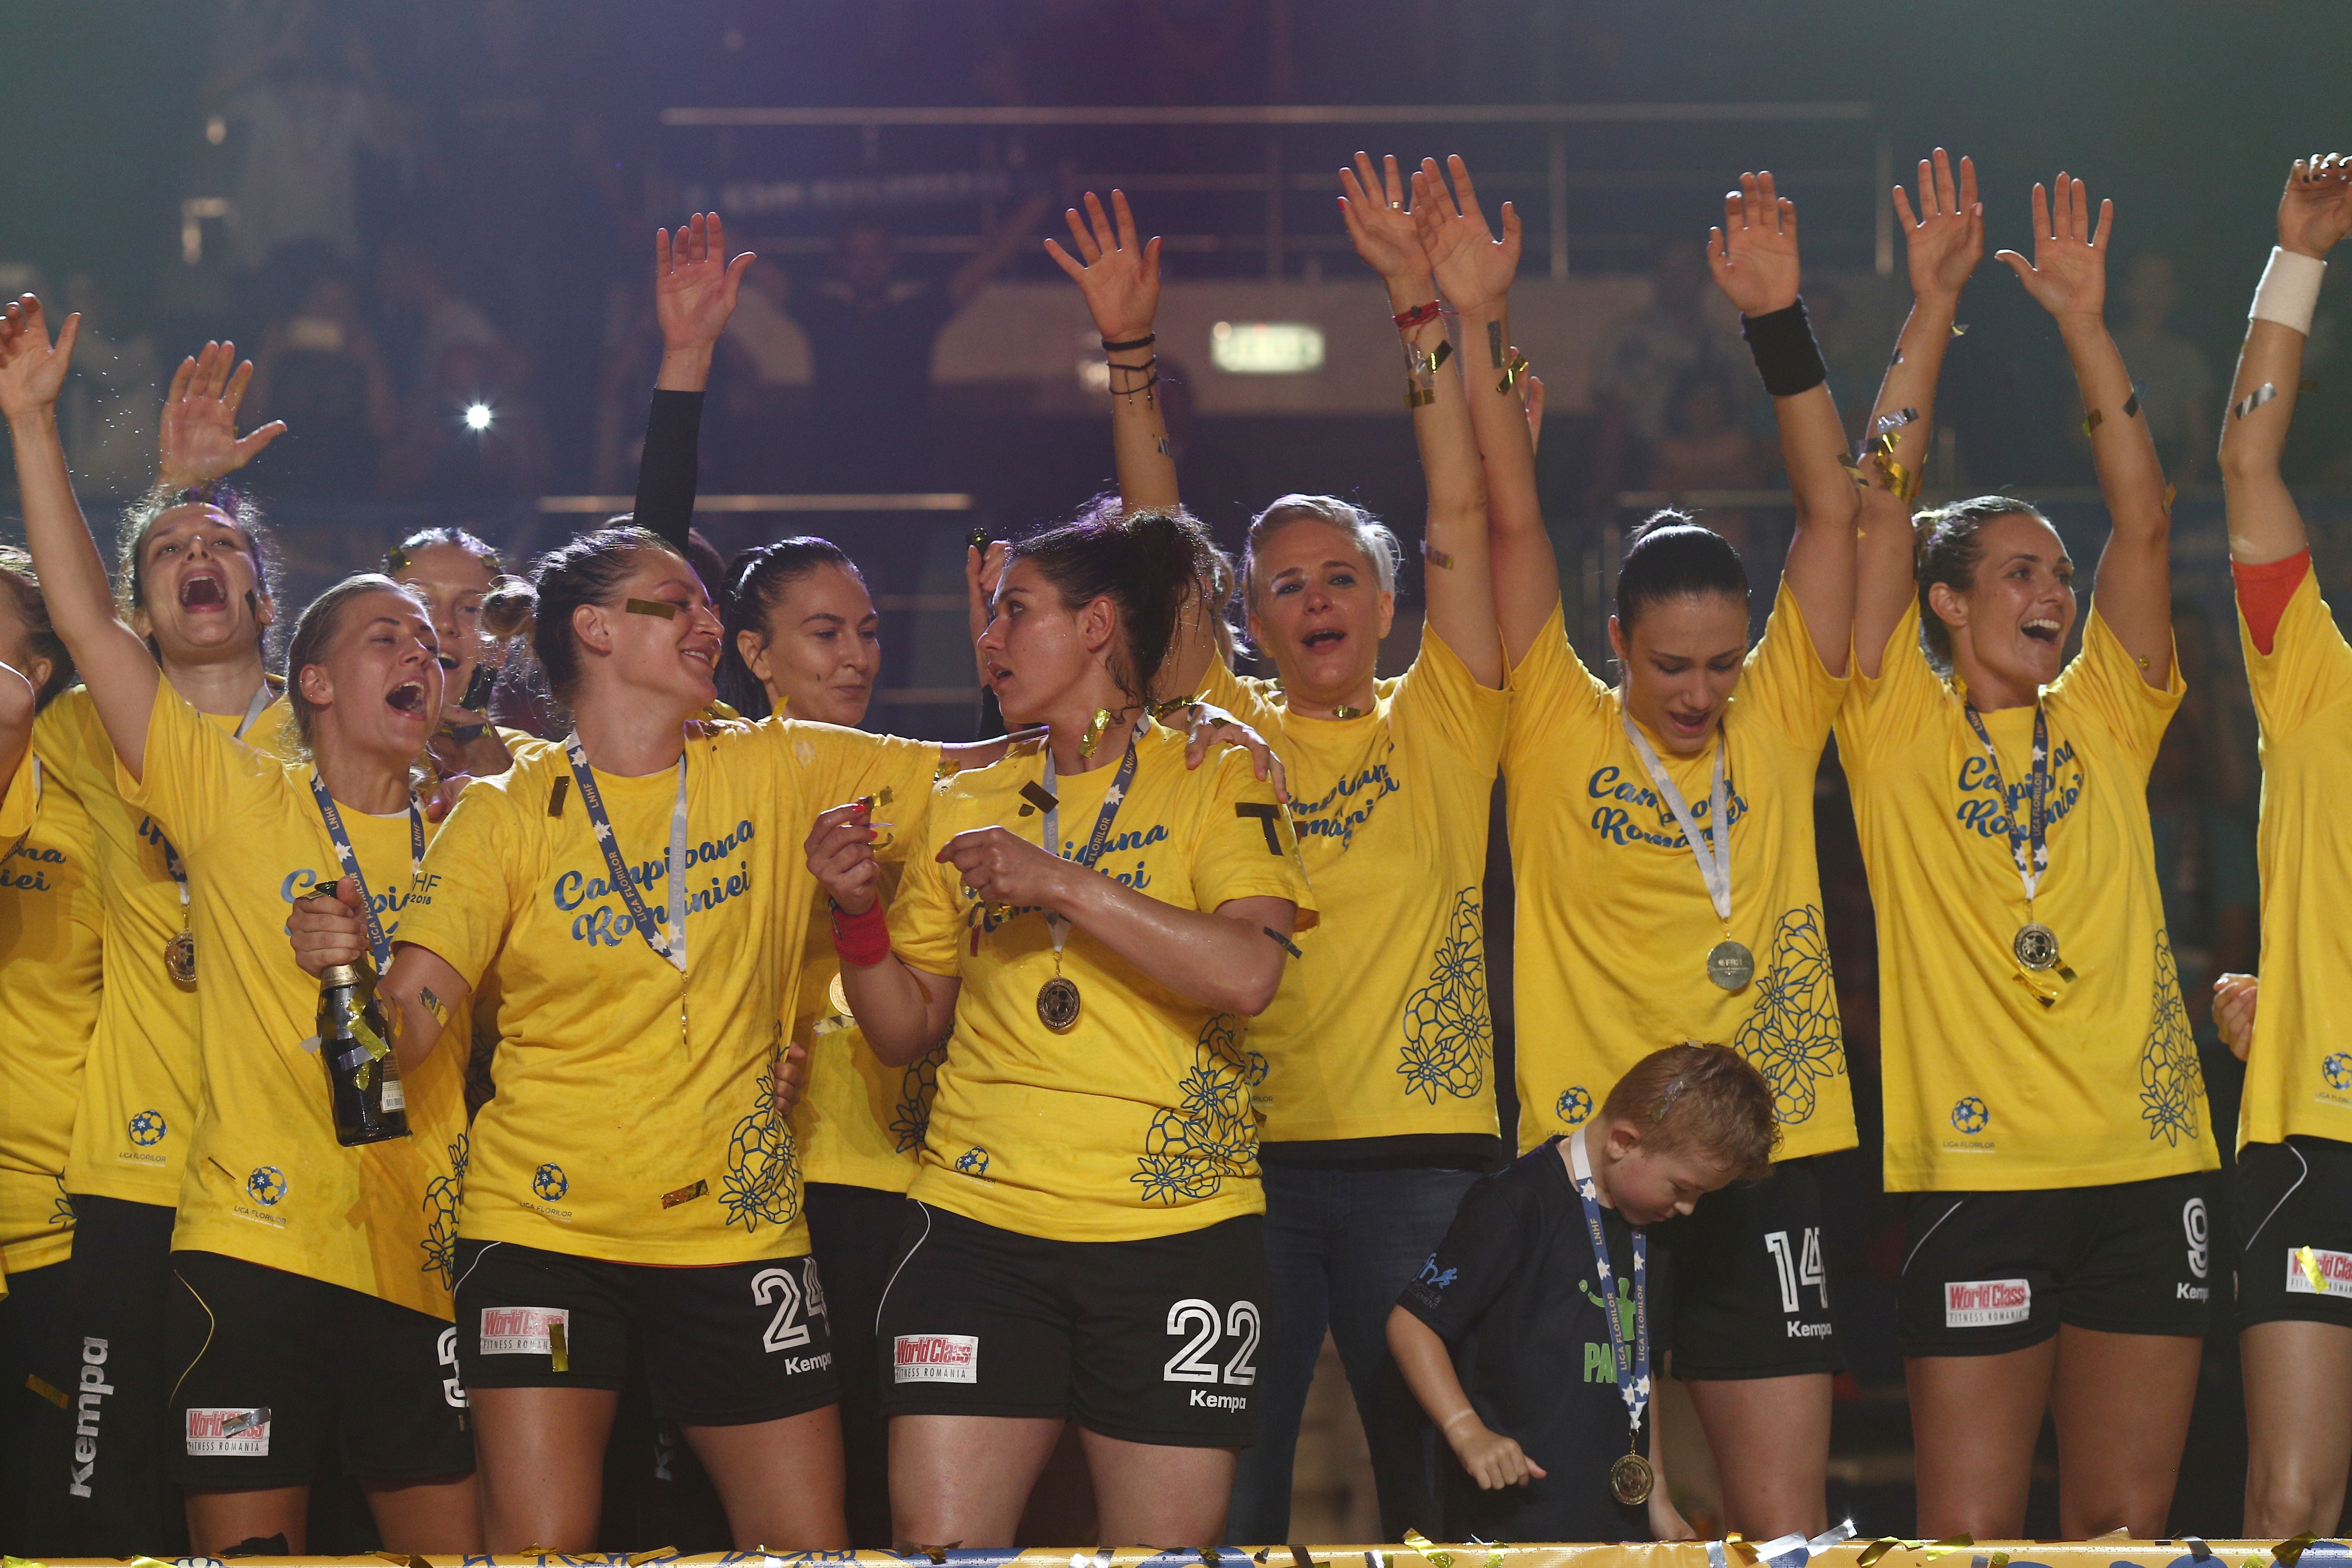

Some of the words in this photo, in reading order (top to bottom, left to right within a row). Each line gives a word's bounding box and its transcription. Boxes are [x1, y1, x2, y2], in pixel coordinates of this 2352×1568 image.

[583, 783, 599, 808] LNHF
[2032, 772, 2043, 818] FLORILOR
[324, 806, 340, 830] LNHF
[413, 821, 422, 847] LNHF
[1088, 817, 1111, 862] FLORILOR
[608, 851, 635, 898] FLORILOR
[631, 898, 648, 922] LIGA
[368, 921, 383, 945] LIGA
[133, 1153, 166, 1162] FLORILOR
[234, 1205, 249, 1215] LIGA
[251, 1210, 287, 1225] FLORILOR
[519, 1201, 534, 1210] LIGA
[536, 1205, 573, 1218] FLORILOR
[1589, 1218, 1603, 1246] LNHF
[1764, 1226, 1828, 1314] 14
[750, 1256, 830, 1354] 24
[1950, 1284, 1990, 1310] World
[1991, 1283, 2026, 1307] Class
[1607, 1292, 1623, 1344] FLORILOR
[1637, 1285, 1645, 1335] FLORILOR
[1951, 1313, 1984, 1322] FITNESS
[1988, 1310, 2022, 1320] ROMANIA
[484, 1310, 524, 1336] World
[1786, 1320, 1832, 1340] Kempa
[483, 1339, 512, 1350] FITNESS
[517, 1340, 551, 1350] ROMAN
[896, 1337, 931, 1365] World
[929, 1337, 972, 1366] Class
[1163, 1298, 1261, 1386] 22
[784, 1352, 832, 1375] Kempa
[1619, 1346, 1628, 1371] LIGA
[897, 1368, 919, 1378] FITNESS
[924, 1368, 966, 1378] ROMANIA
[1189, 1389, 1246, 1414] Kempa
[69, 1336, 114, 1498] Kempa
[189, 1411, 225, 1438] World
[188, 1442, 214, 1451] FITNESS
[219, 1442, 259, 1452] ROMANIA
